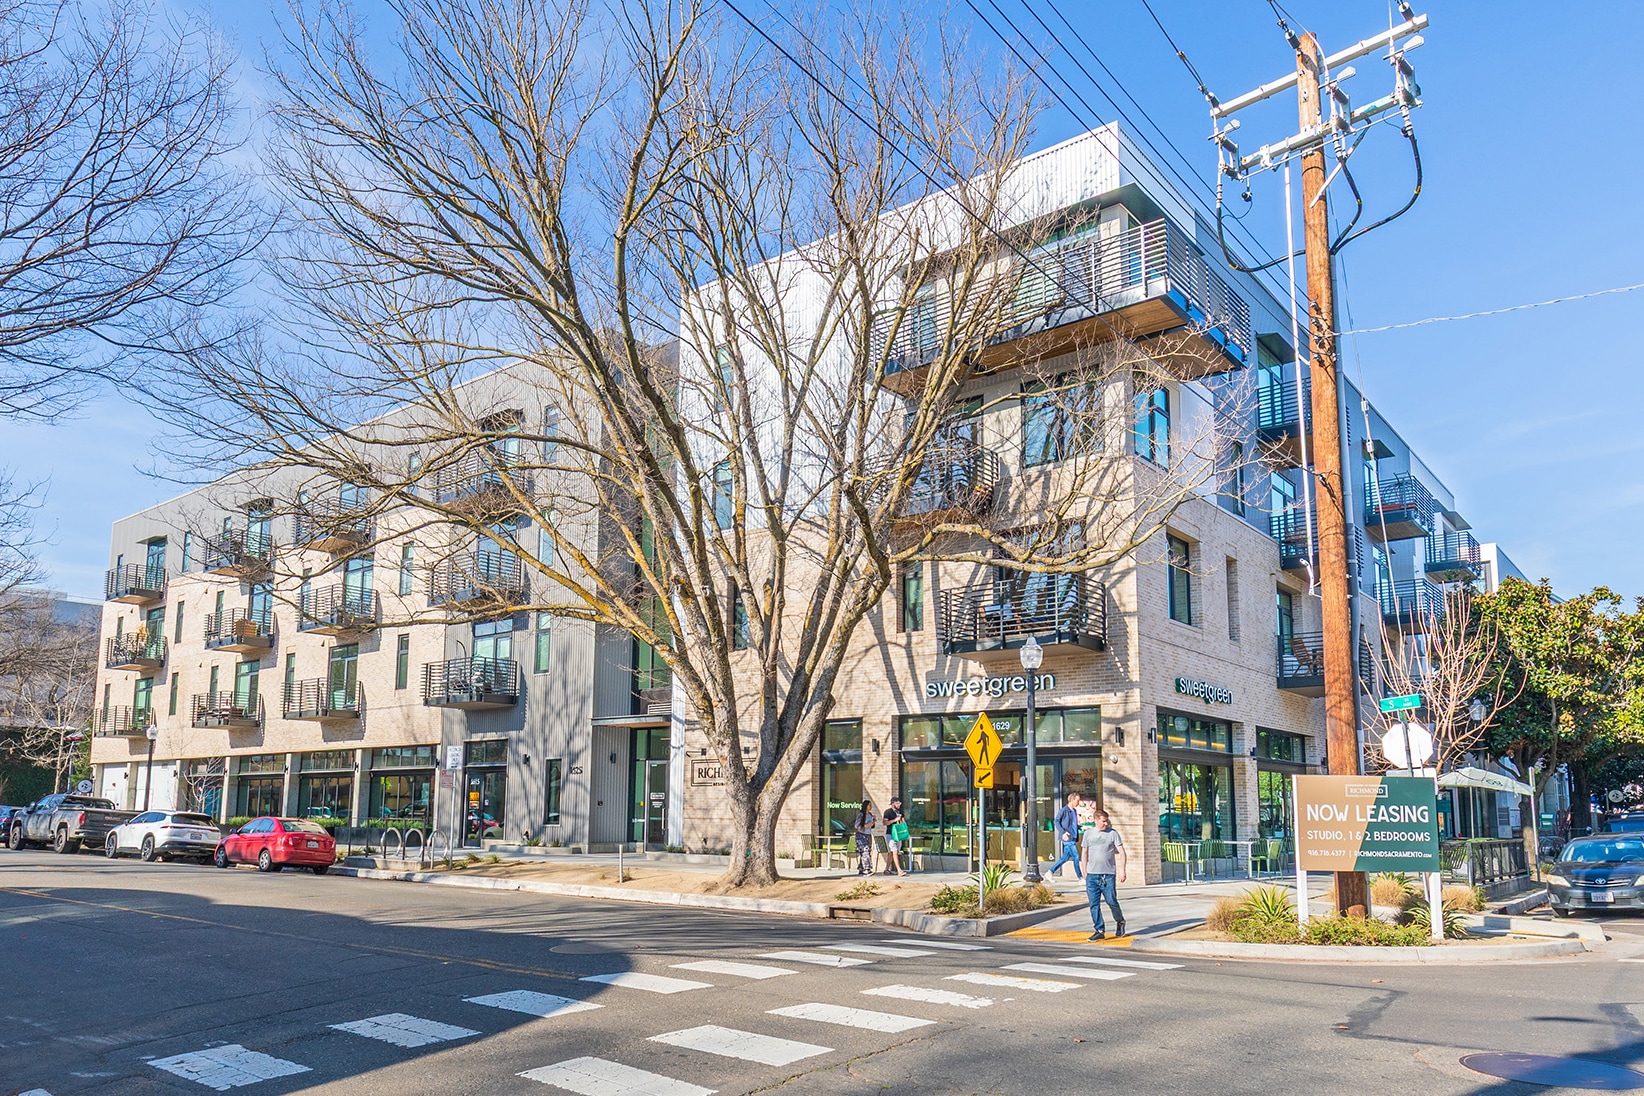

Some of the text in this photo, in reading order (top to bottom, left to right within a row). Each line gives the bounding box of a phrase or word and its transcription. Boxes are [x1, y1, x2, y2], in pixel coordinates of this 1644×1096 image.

[1177, 677, 1233, 704] sweetgreen
[1389, 700, 1394, 709] S
[992, 721, 1010, 730] 1629
[698, 767, 724, 779] RICH
[827, 801, 862, 810] Now Serving
[1306, 804, 1429, 823] NOW LEASING
[1307, 830, 1431, 842] STUDIO, 1 & 2 BEDROOMS
